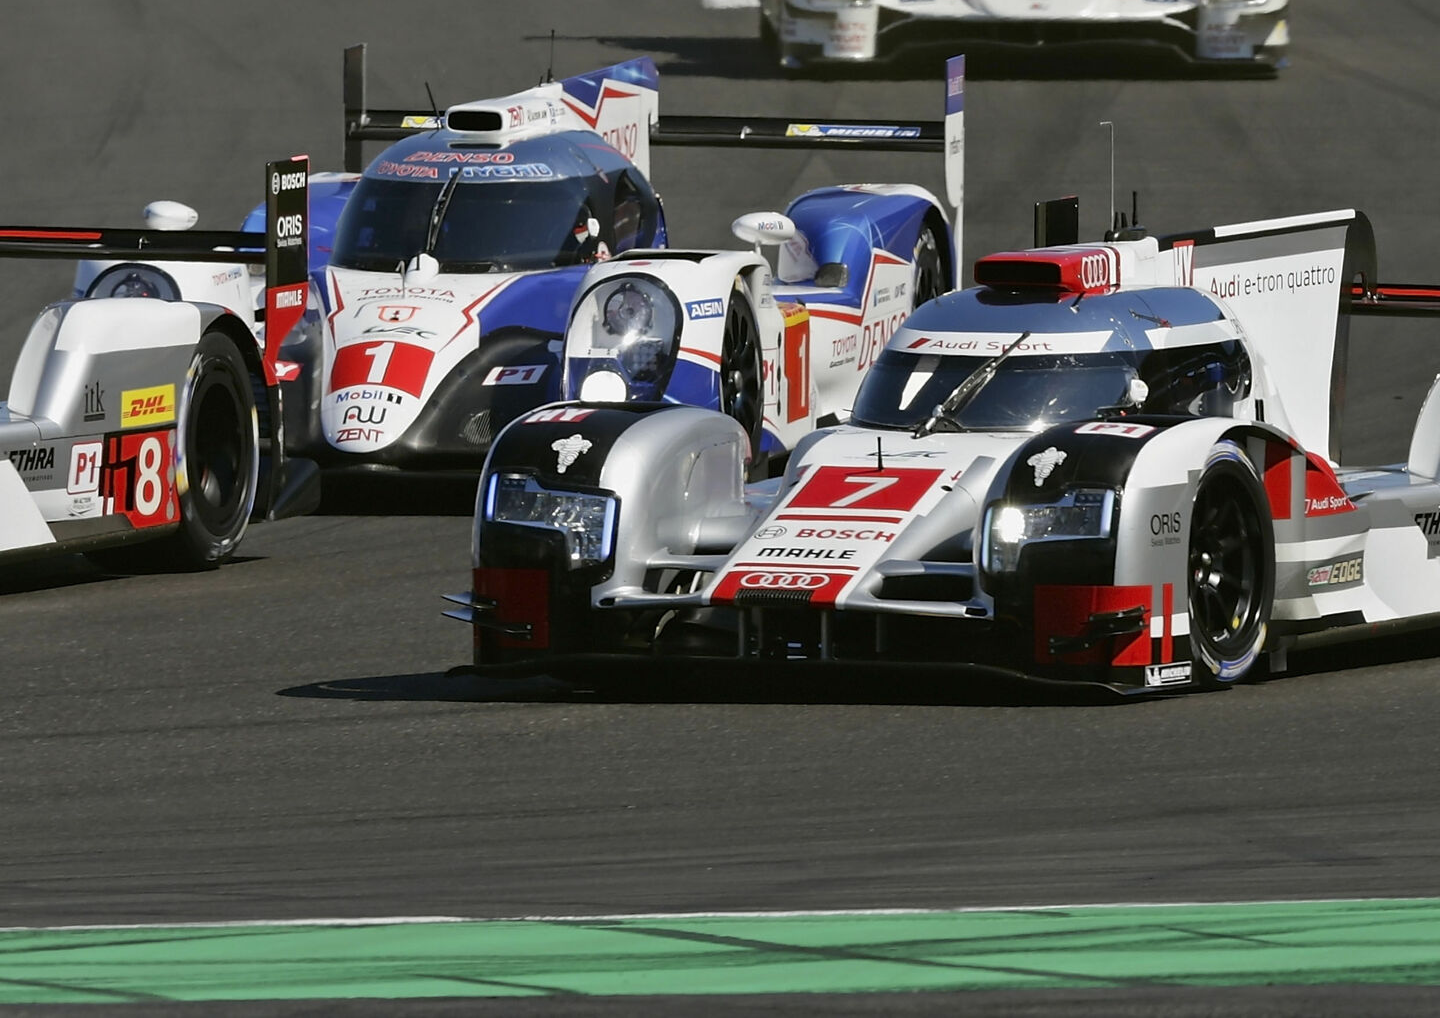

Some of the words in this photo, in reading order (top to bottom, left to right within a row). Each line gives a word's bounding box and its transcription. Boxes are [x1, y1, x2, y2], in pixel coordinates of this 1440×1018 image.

[826, 127, 920, 137] MICHELIN
[404, 151, 516, 165] DENSO
[281, 171, 306, 190] BOSCH
[277, 214, 303, 238] ORIS
[1210, 274, 1240, 299] Audi
[1244, 273, 1284, 295] e-tron
[1287, 265, 1335, 294] quattro
[362, 286, 457, 298] TOYOTA
[690, 299, 724, 318] AISIN
[929, 340, 979, 350] Audi
[985, 340, 1054, 353] Sport
[364, 342, 397, 384] 1
[798, 333, 808, 409] 1
[495, 367, 536, 382] P1
[84, 382, 105, 414] itk
[130, 395, 166, 418] DHL
[335, 390, 384, 405] Mobil
[336, 428, 385, 444] ZENT
[75, 451, 97, 485] P1
[136, 436, 163, 516] 8
[828, 475, 900, 508] 7
[1310, 497, 1330, 511] Audi
[1330, 495, 1347, 510] Sport
[1150, 511, 1182, 536] ORIS
[795, 528, 896, 543] BOSCH
[756, 547, 857, 560] MAHLE
[1329, 557, 1362, 584] EDGE
